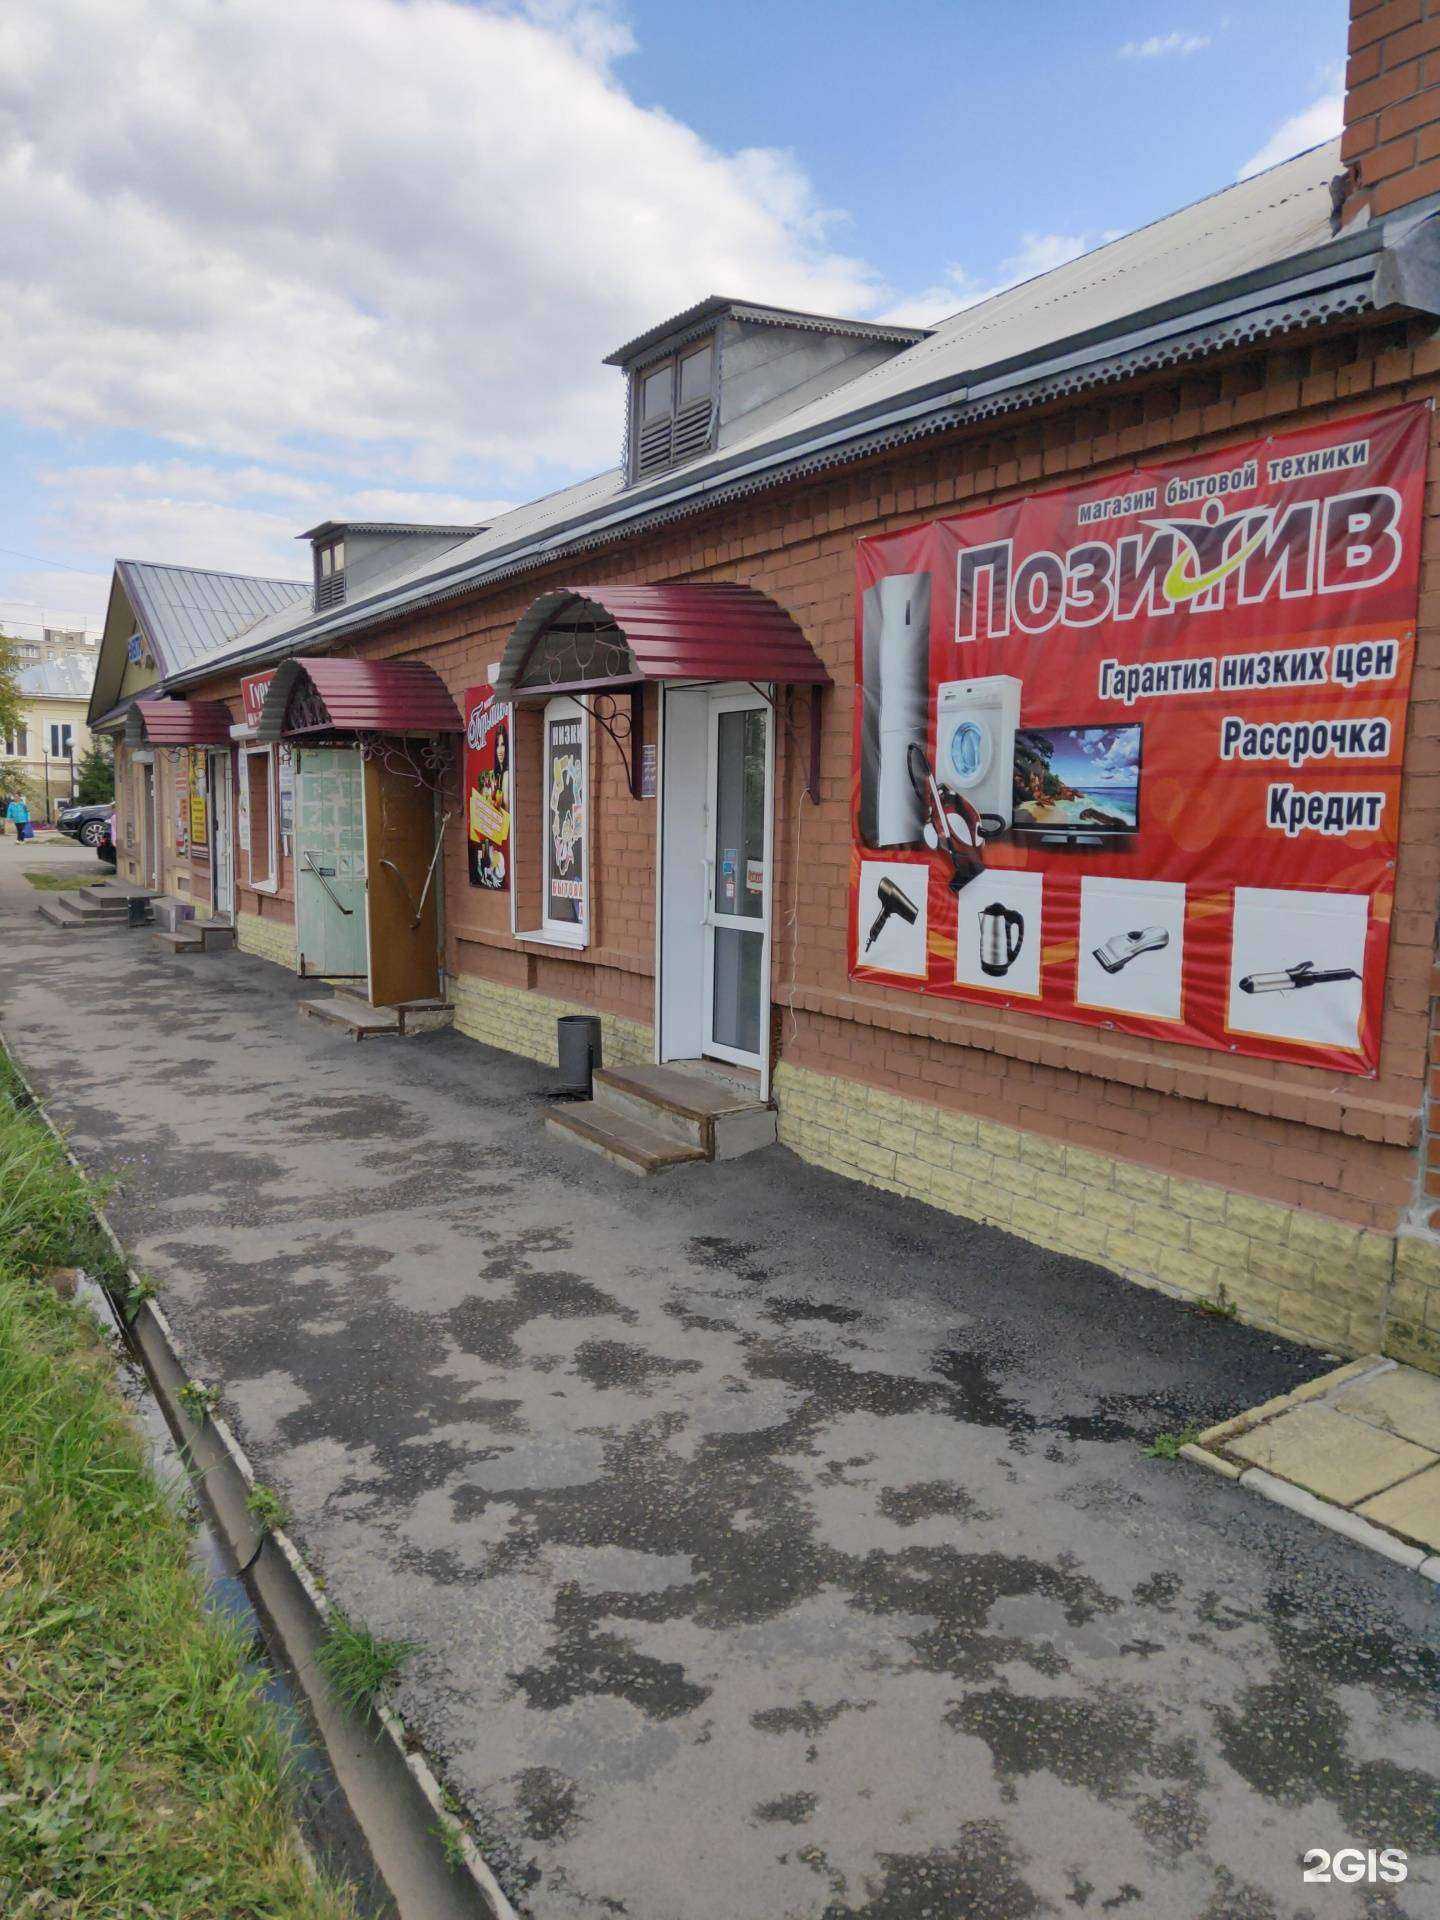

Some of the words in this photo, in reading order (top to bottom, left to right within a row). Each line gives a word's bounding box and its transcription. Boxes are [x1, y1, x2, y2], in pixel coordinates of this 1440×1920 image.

[1079, 489, 1158, 526] магазин
[1165, 462, 1258, 504] бытовой
[1268, 439, 1370, 484] техники
[1099, 658, 1218, 706] Гарантия
[1220, 648, 1327, 691] низких
[1336, 640, 1400, 687] цен
[1220, 716, 1391, 766] Рассрочка
[1267, 784, 1387, 838] Кредит
